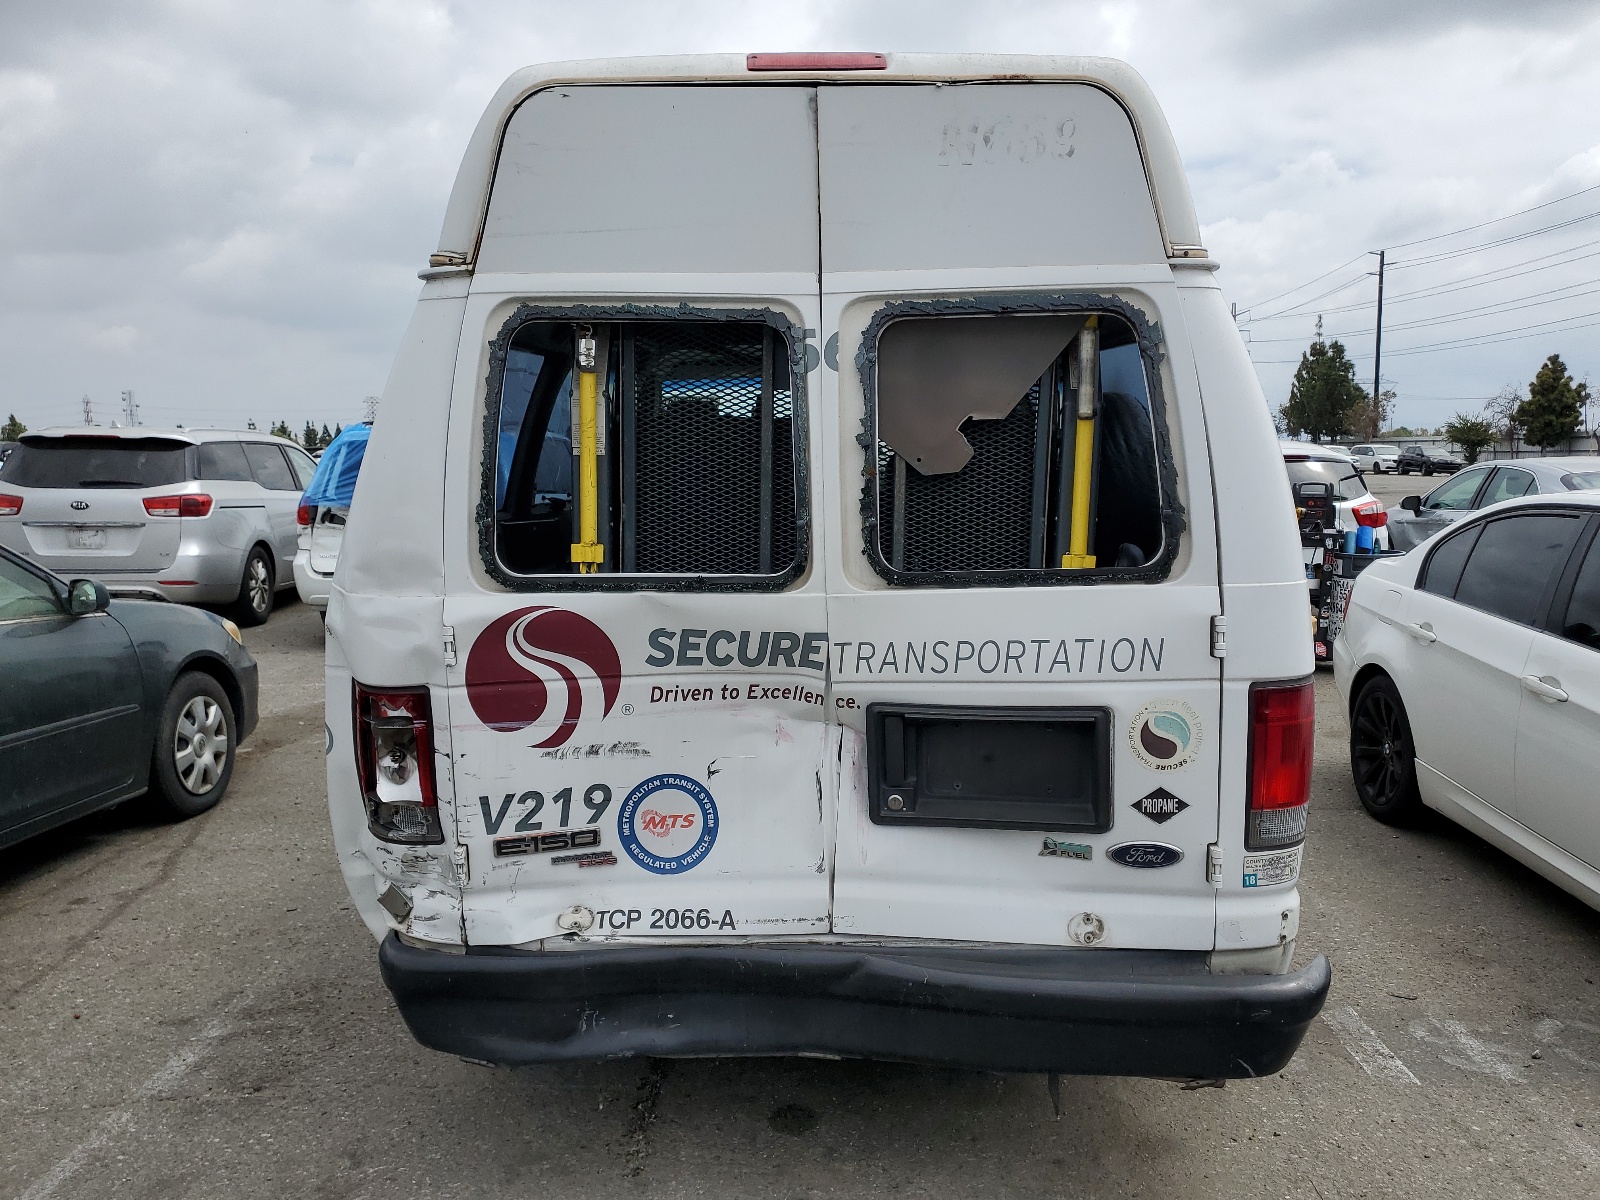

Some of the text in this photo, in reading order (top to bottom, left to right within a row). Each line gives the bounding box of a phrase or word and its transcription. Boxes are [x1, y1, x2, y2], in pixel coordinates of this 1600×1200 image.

[644, 627, 1165, 674] SECURE TRANSPORTATION
[650, 683, 861, 709] Driven to Excellence.
[1154, 758, 1188, 771] SECURE
[478, 783, 613, 836] V219
[622, 777, 715, 836] METROPOLITAN TRANSIT SYSTEM
[1142, 798, 1179, 814] PROPANE
[641, 813, 696, 830] MTS
[629, 834, 712, 870] REGULATED VEHICLE
[1060, 850, 1089, 860] FUEL
[1125, 847, 1165, 863] Ford
[1244, 875, 1256, 886] 18
[596, 908, 737, 931] TCP 2066-A
